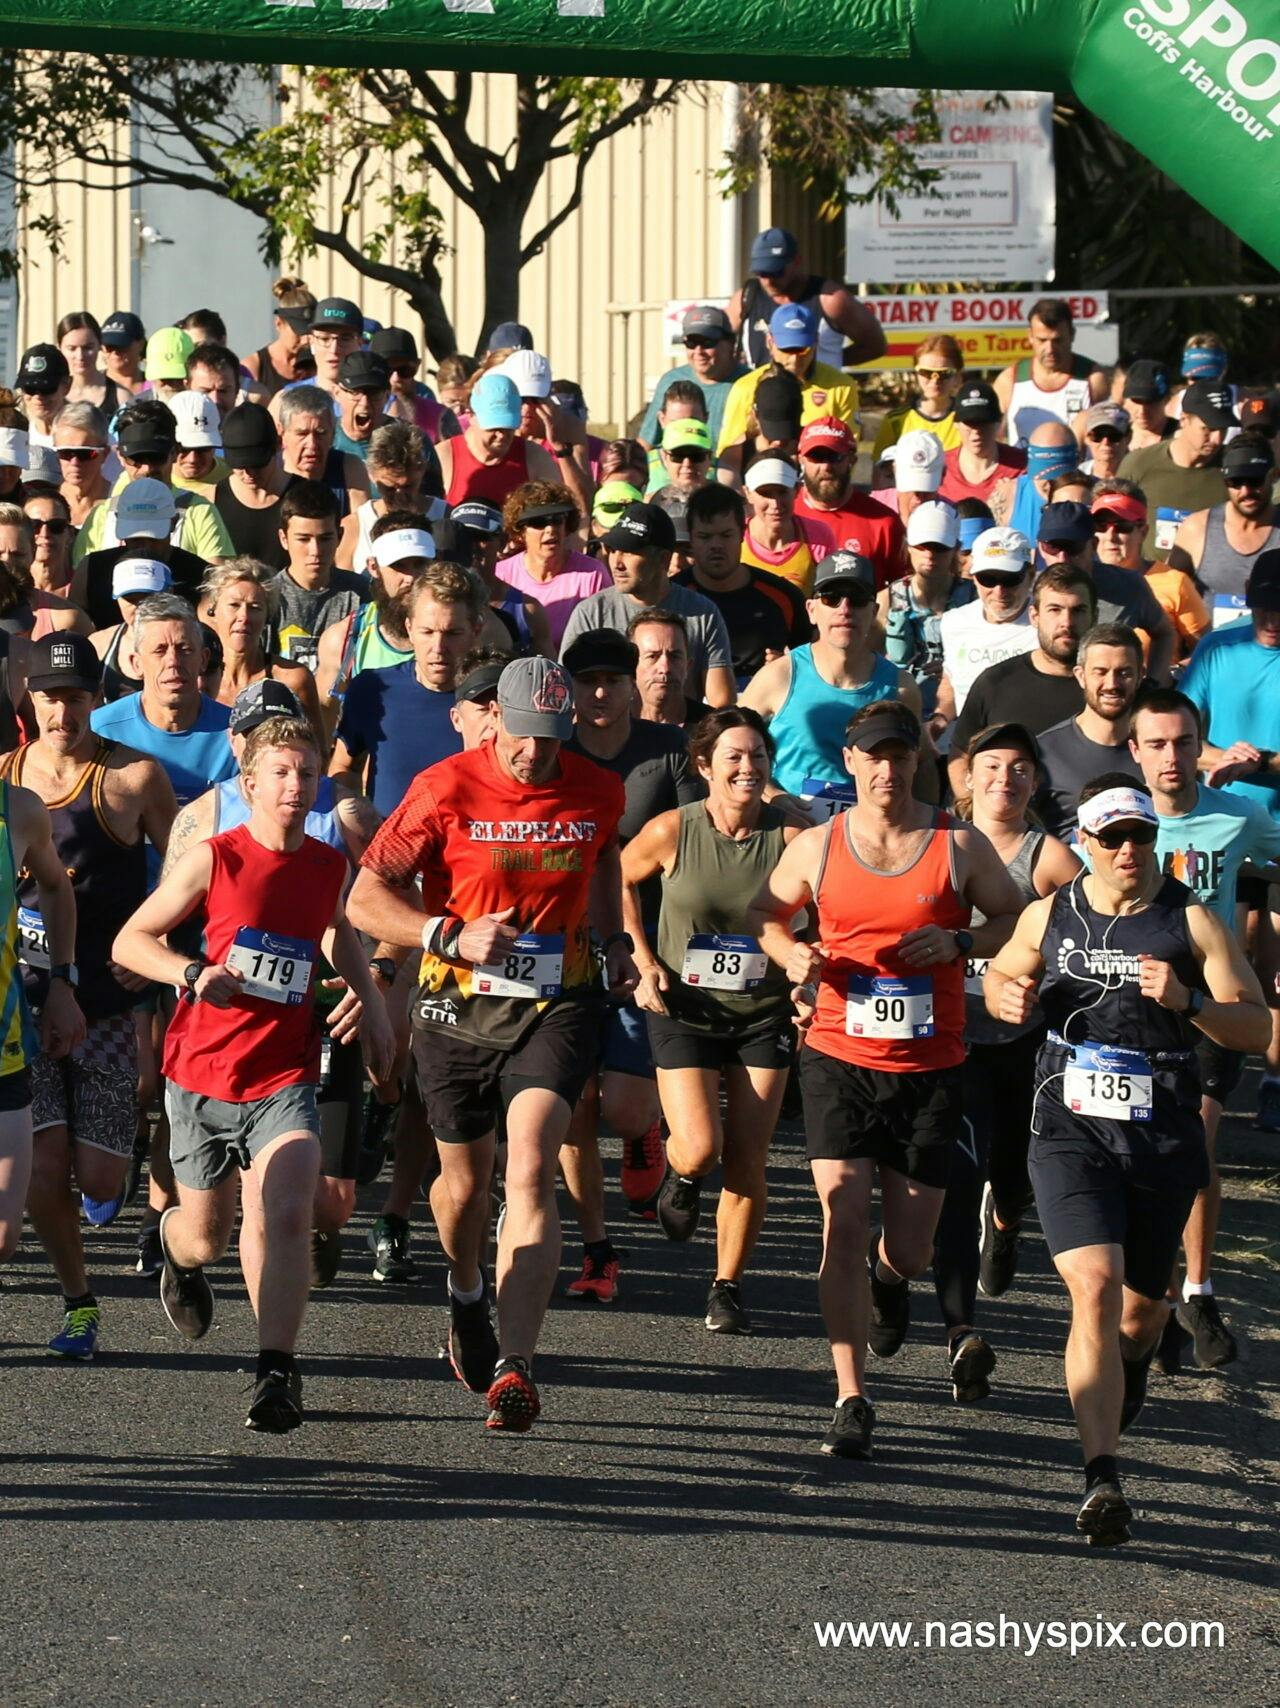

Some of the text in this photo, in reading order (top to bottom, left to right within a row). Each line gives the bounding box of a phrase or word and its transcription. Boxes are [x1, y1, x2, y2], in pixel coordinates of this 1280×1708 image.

[1123, 8, 1274, 142] Coffs Harbour
[951, 299, 1024, 322] BOOK
[53, 647, 72, 656] SALT
[53, 656, 72, 664] MILL
[467, 820, 598, 843] ELEPHANT
[489, 848, 584, 872] TRAIL RACE
[251, 952, 295, 986] 119
[504, 954, 537, 982] 82
[712, 952, 741, 976] 83
[420, 1006, 458, 1027] CTTR
[874, 998, 906, 1023] 90
[917, 1025, 928, 1035] 90
[1086, 1072, 1132, 1102] 135
[1133, 1108, 1149, 1119] 135
